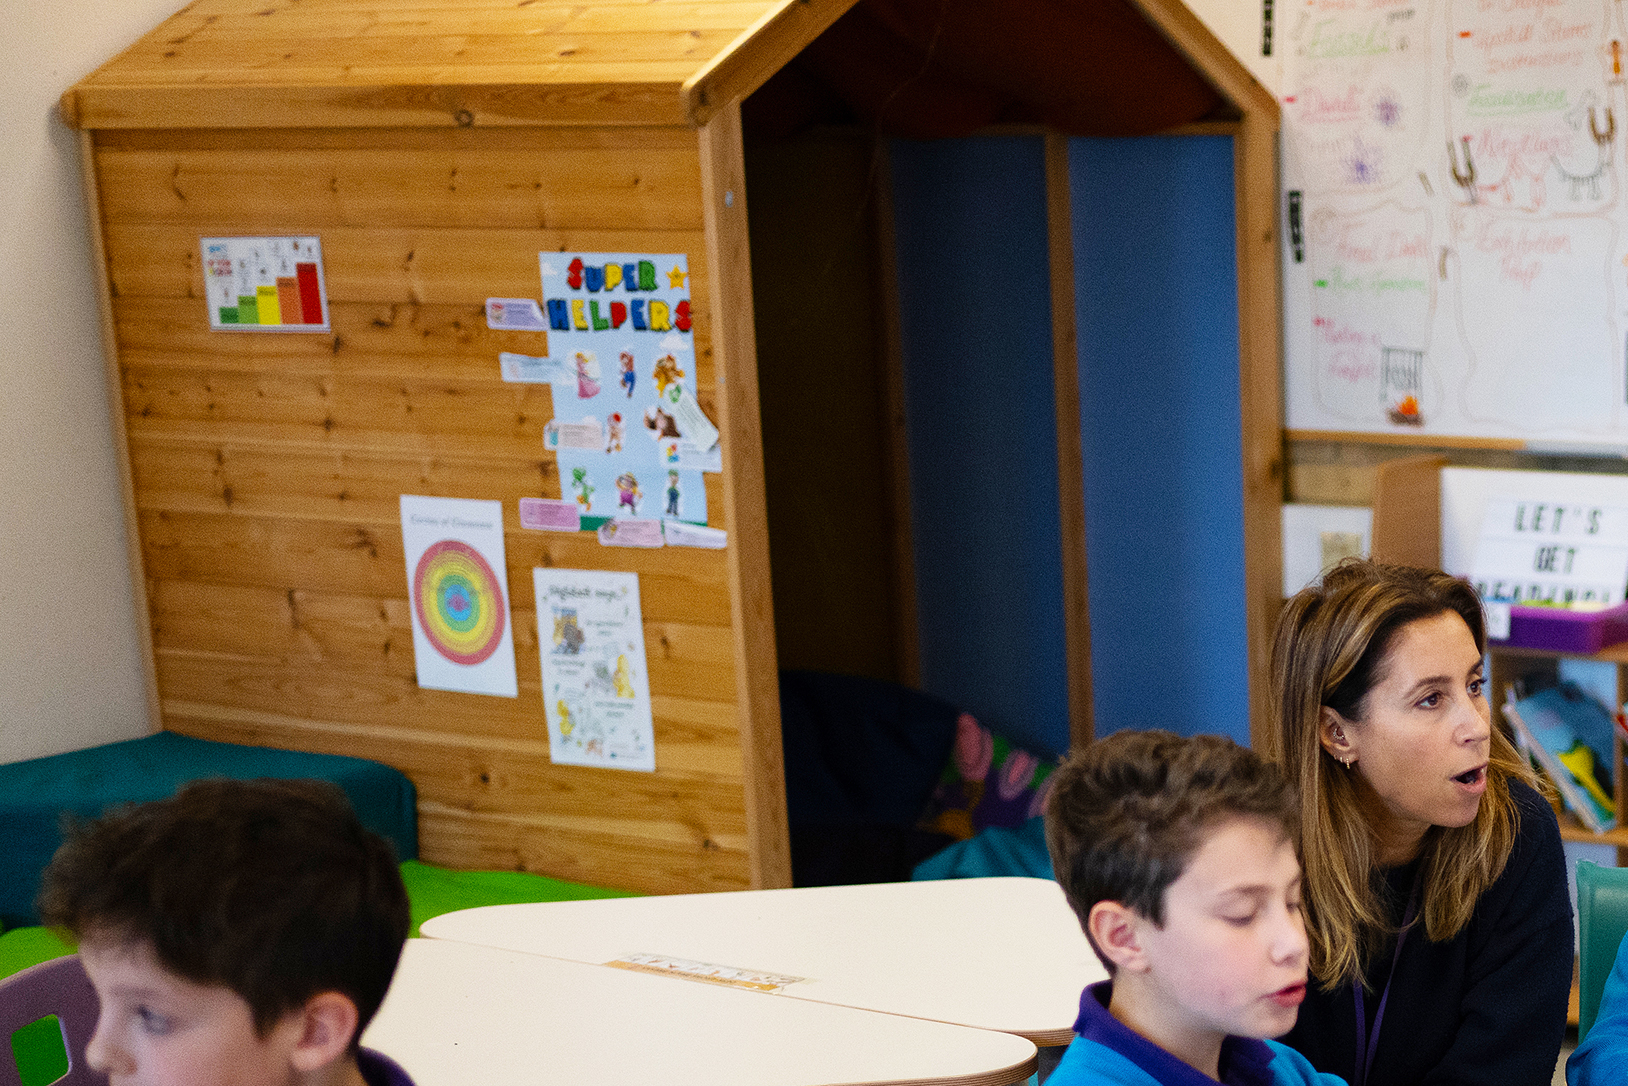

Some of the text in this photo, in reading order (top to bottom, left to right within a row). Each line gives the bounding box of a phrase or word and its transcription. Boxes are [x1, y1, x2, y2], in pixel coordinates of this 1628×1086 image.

[567, 257, 658, 292] SUPER
[547, 299, 692, 332] HELPERS
[1514, 504, 1602, 534] LET'S
[1534, 545, 1580, 573] GET
